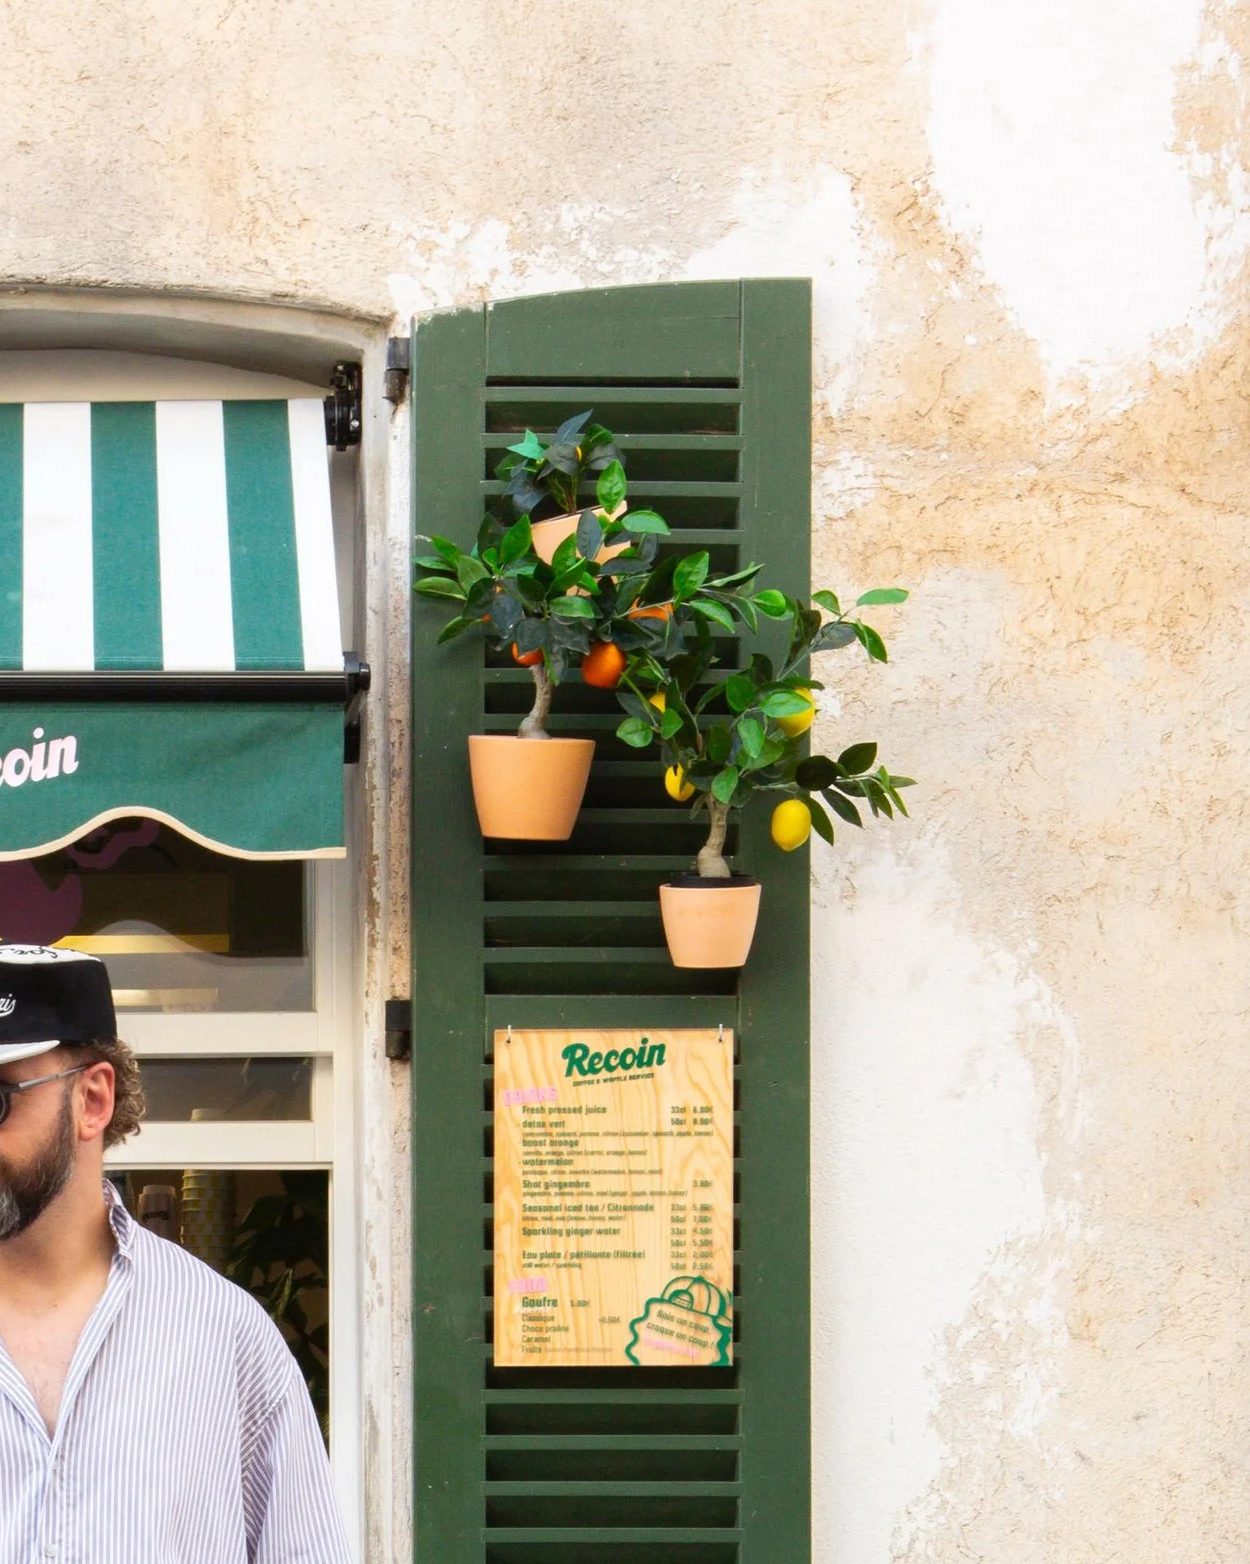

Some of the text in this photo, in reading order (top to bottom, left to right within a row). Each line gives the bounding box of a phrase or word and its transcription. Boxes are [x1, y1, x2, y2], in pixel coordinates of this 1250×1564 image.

[561, 1037, 666, 1078] Recoin
[522, 1104, 607, 1116] Fresh pressed juice
[522, 1119, 565, 1129] detox vert
[522, 1138, 579, 1149] boost orange
[522, 1157, 574, 1166] watermelon
[522, 1179, 590, 1190] Shot gingembre
[522, 1203, 562, 1212] Seasonal
[564, 1203, 583, 1212] iced
[585, 1204, 600, 1212] tea
[607, 1203, 655, 1212] Citronnade
[522, 1226, 621, 1237] Sparkling ginger water
[522, 1250, 537, 1259] Eau
[539, 1250, 561, 1260] plate
[522, 1296, 558, 1308] Gaufre
[522, 1313, 555, 1323] Classique
[656, 1308, 675, 1323] Bois
[676, 1317, 688, 1326] un
[522, 1324, 544, 1333] Choco
[522, 1335, 551, 1344] Caramel
[646, 1322, 675, 1336] croque
[676, 1331, 687, 1340] un
[688, 1335, 709, 1348] coup
